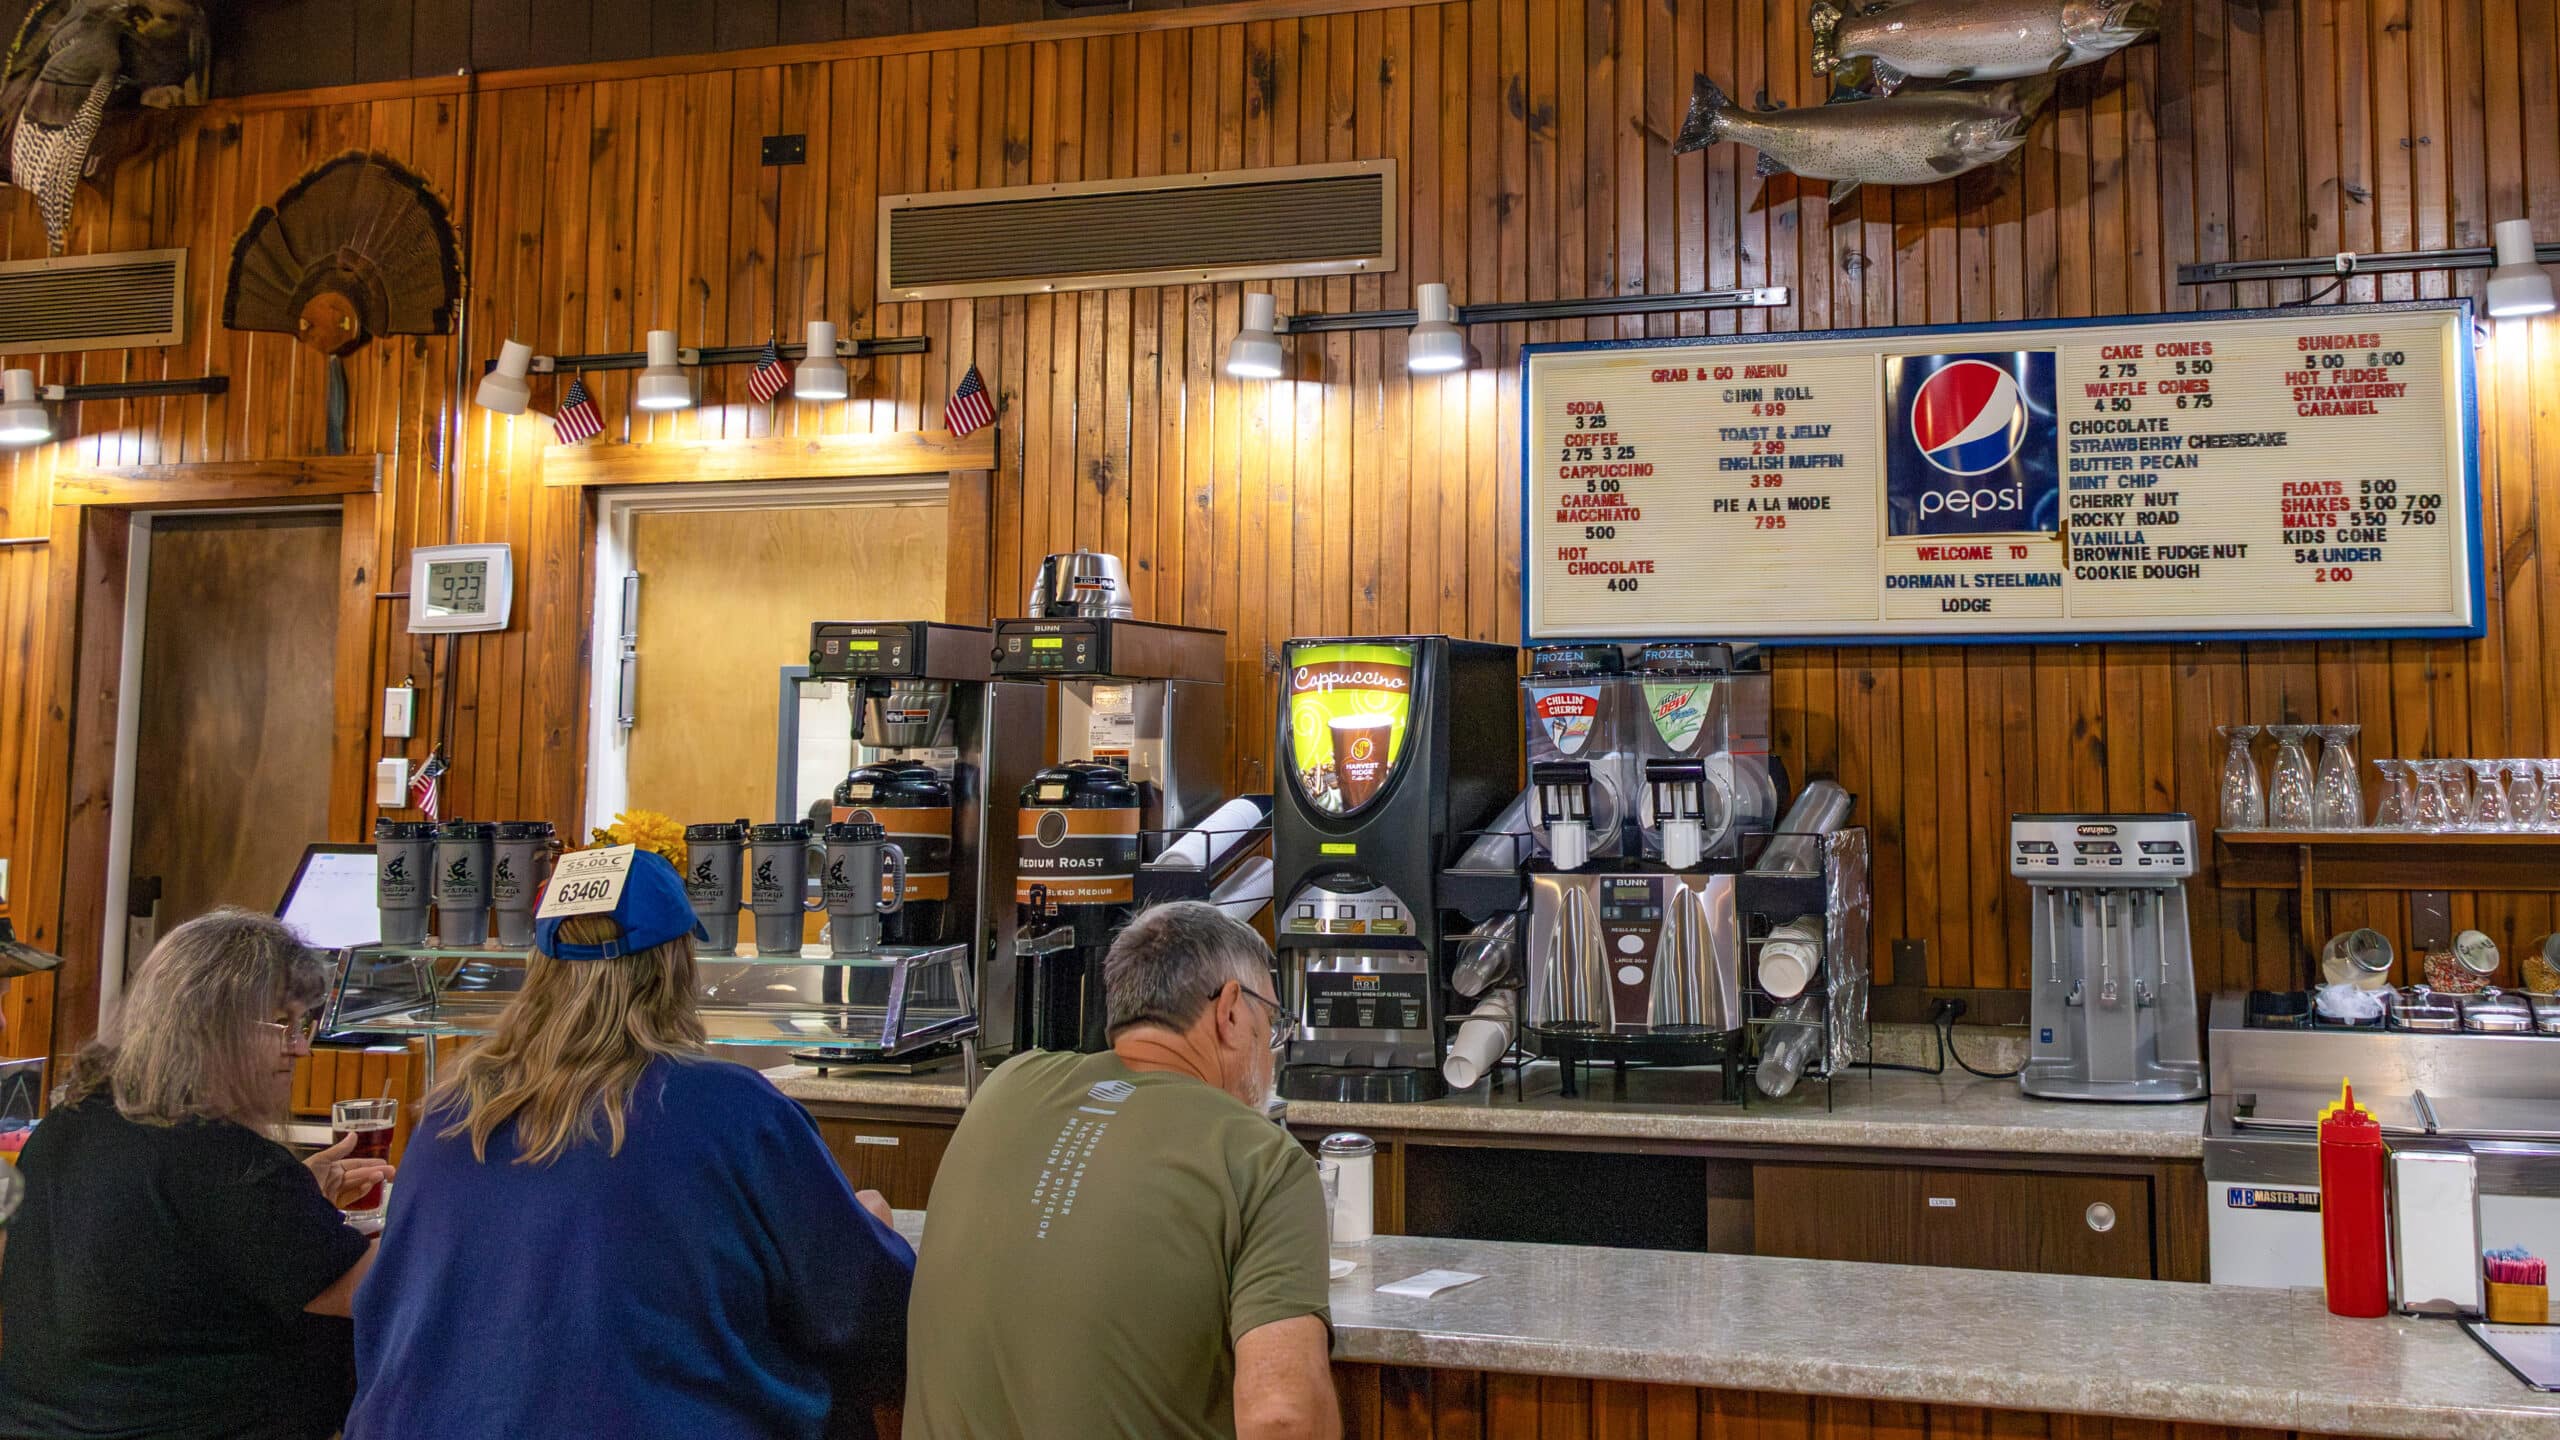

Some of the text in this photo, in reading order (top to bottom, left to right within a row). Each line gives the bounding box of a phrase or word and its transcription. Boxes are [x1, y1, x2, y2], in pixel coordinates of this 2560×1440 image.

[2298, 334, 2380, 350] SUNDAES
[2102, 342, 2212, 360] CAKE CONES
[1652, 364, 1787, 383] GRAB & GO MENU
[2285, 368, 2388, 385] HOT FUDGE
[1774, 387, 1813, 401] ROLL
[2085, 380, 2209, 397] WAFFLE CONES
[2293, 383, 2407, 401] STRAWBERRY
[1567, 402, 1604, 415] SODA
[2297, 402, 2378, 417] CARAMEL
[1719, 425, 1831, 441] TOAST & JELLY
[2069, 419, 2168, 434] CHOCOLATE
[1564, 433, 1618, 447] COFFEE
[2070, 433, 2287, 453] STRAWBERRY CHEESECAKE
[1719, 455, 1843, 471] ENGLISH MUFFIN
[2070, 455, 2198, 471] BUTTER PECAN
[1560, 464, 1653, 479] CAPPUCCINO
[2070, 474, 2158, 490] MINT CHIP
[2283, 481, 2342, 496] FLOATS
[1561, 494, 1627, 508] CARAMEL
[1714, 497, 1831, 512] PIE A LA MODE
[1920, 483, 2023, 520] pepsi
[2070, 493, 2178, 508] CHERRY NUT
[2281, 497, 2350, 512] SHAKES
[1557, 508, 1640, 523] MACCHIATO
[1755, 516, 1786, 529] 795
[2071, 512, 2179, 527] ROCKY ROAD
[2283, 513, 2336, 528] MALTS
[1585, 527, 1615, 539] 500
[2072, 531, 2145, 545] VANILLA
[2283, 528, 2387, 544] KIDS CONE
[1558, 548, 1587, 560] HOT
[1917, 546, 2028, 561] WELCOME TO
[2074, 545, 2248, 561] BROWNIE FUDGE NUT
[2324, 548, 2381, 562] UNDER
[1568, 561, 1654, 575] CHOCOLATE
[2075, 565, 2200, 580] COOKIE DOUGH
[1608, 579, 1638, 591] 400
[1886, 573, 2061, 588] DORMAN L STEELMAN
[1942, 599, 1991, 613] LODGE
[1536, 651, 1584, 664] FROZEN
[1645, 649, 1694, 661] FROZEN
[1295, 667, 1406, 695] Cappuccino
[1548, 705, 1584, 715] CHERRY
[1059, 857, 1104, 868] ROAST
[558, 879, 610, 903] 63460
[1078, 887, 1112, 895] MEDIUM
[1031, 1118, 1078, 1205] MISSION MADE
[1061, 1122, 1108, 1215] UNDER ARMOUR
[1037, 1121, 1093, 1239] TACTICAL DIVISION
[2255, 1190, 2319, 1205] MASTER-BILT
